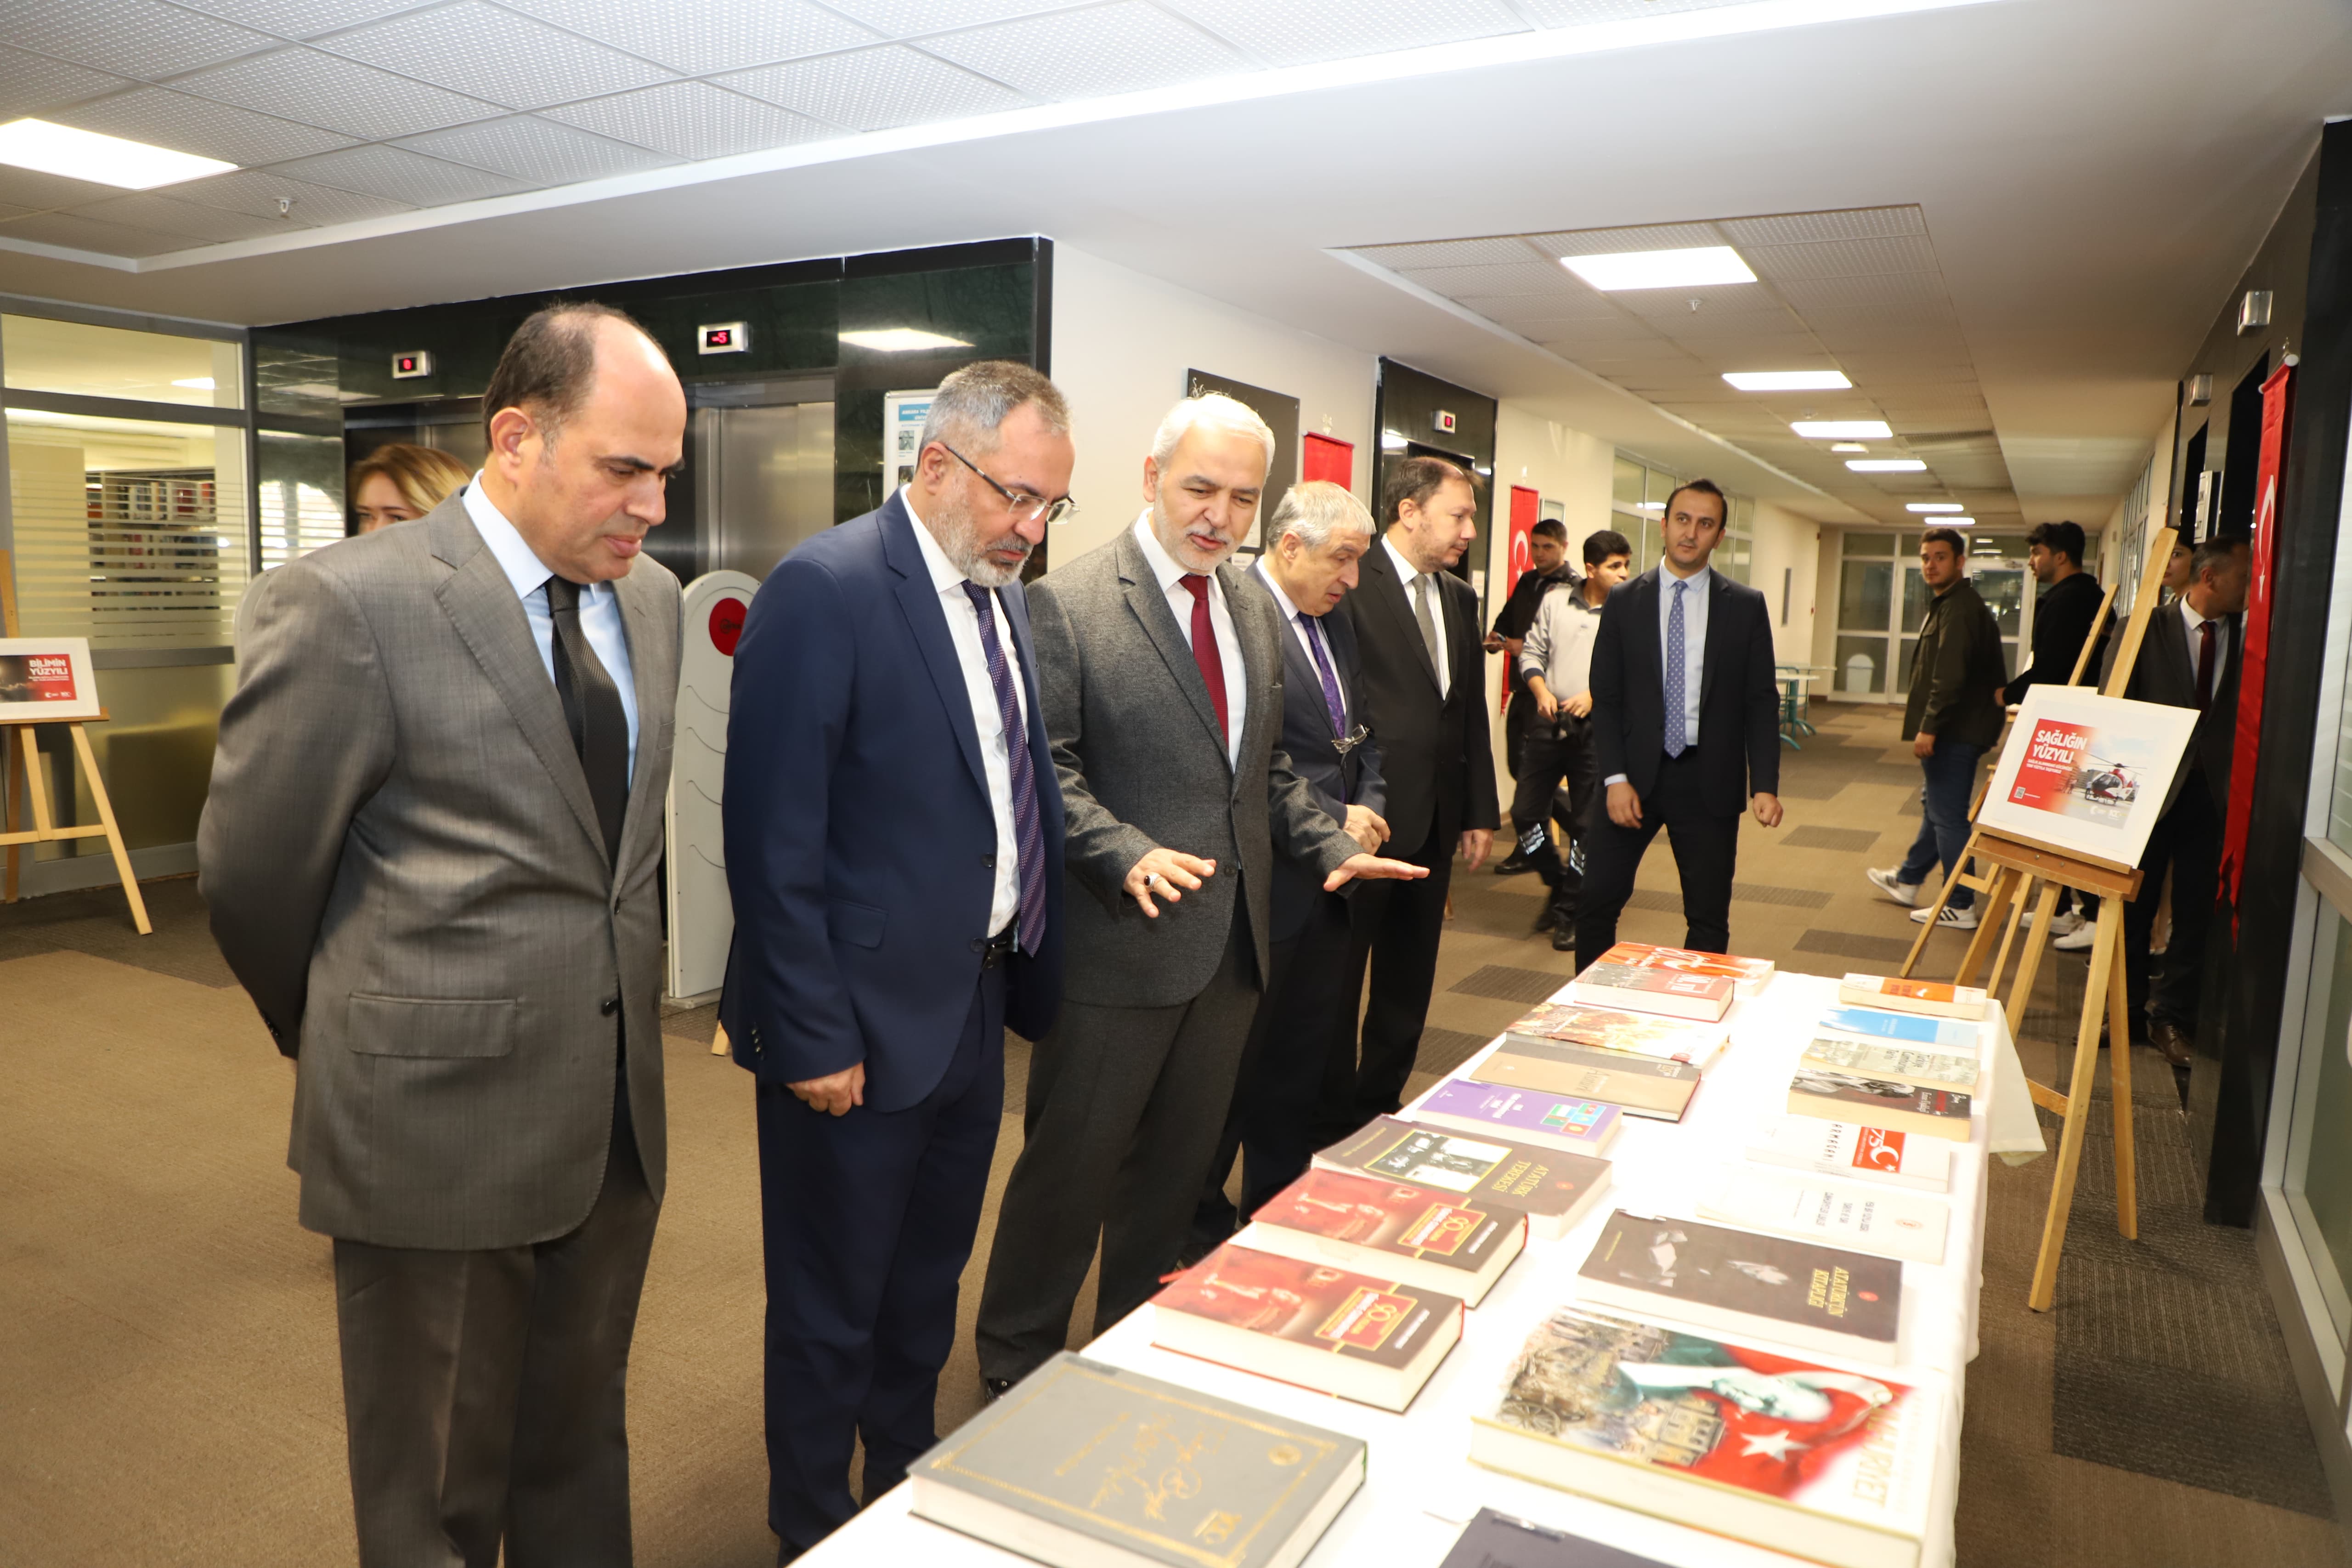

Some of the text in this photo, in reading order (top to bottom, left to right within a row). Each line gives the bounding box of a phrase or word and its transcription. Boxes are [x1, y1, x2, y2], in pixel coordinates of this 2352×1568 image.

[712, 331, 728, 344] -5
[29, 658, 66, 668] BİLİMİN
[29, 667, 68, 675] YÜZYILI
[2035, 730, 2088, 750] SAĞLIĞIN
[2032, 743, 2075, 764] YÜZYILI
[1822, 1124, 1843, 1161] ARMAĞANI
[1868, 1127, 1885, 1148] 75
[1492, 1160, 1532, 1193] TEREKESİ
[1512, 1165, 1549, 1197] ATATÜRK
[1808, 1268, 1832, 1308] KİTAPLIĞI
